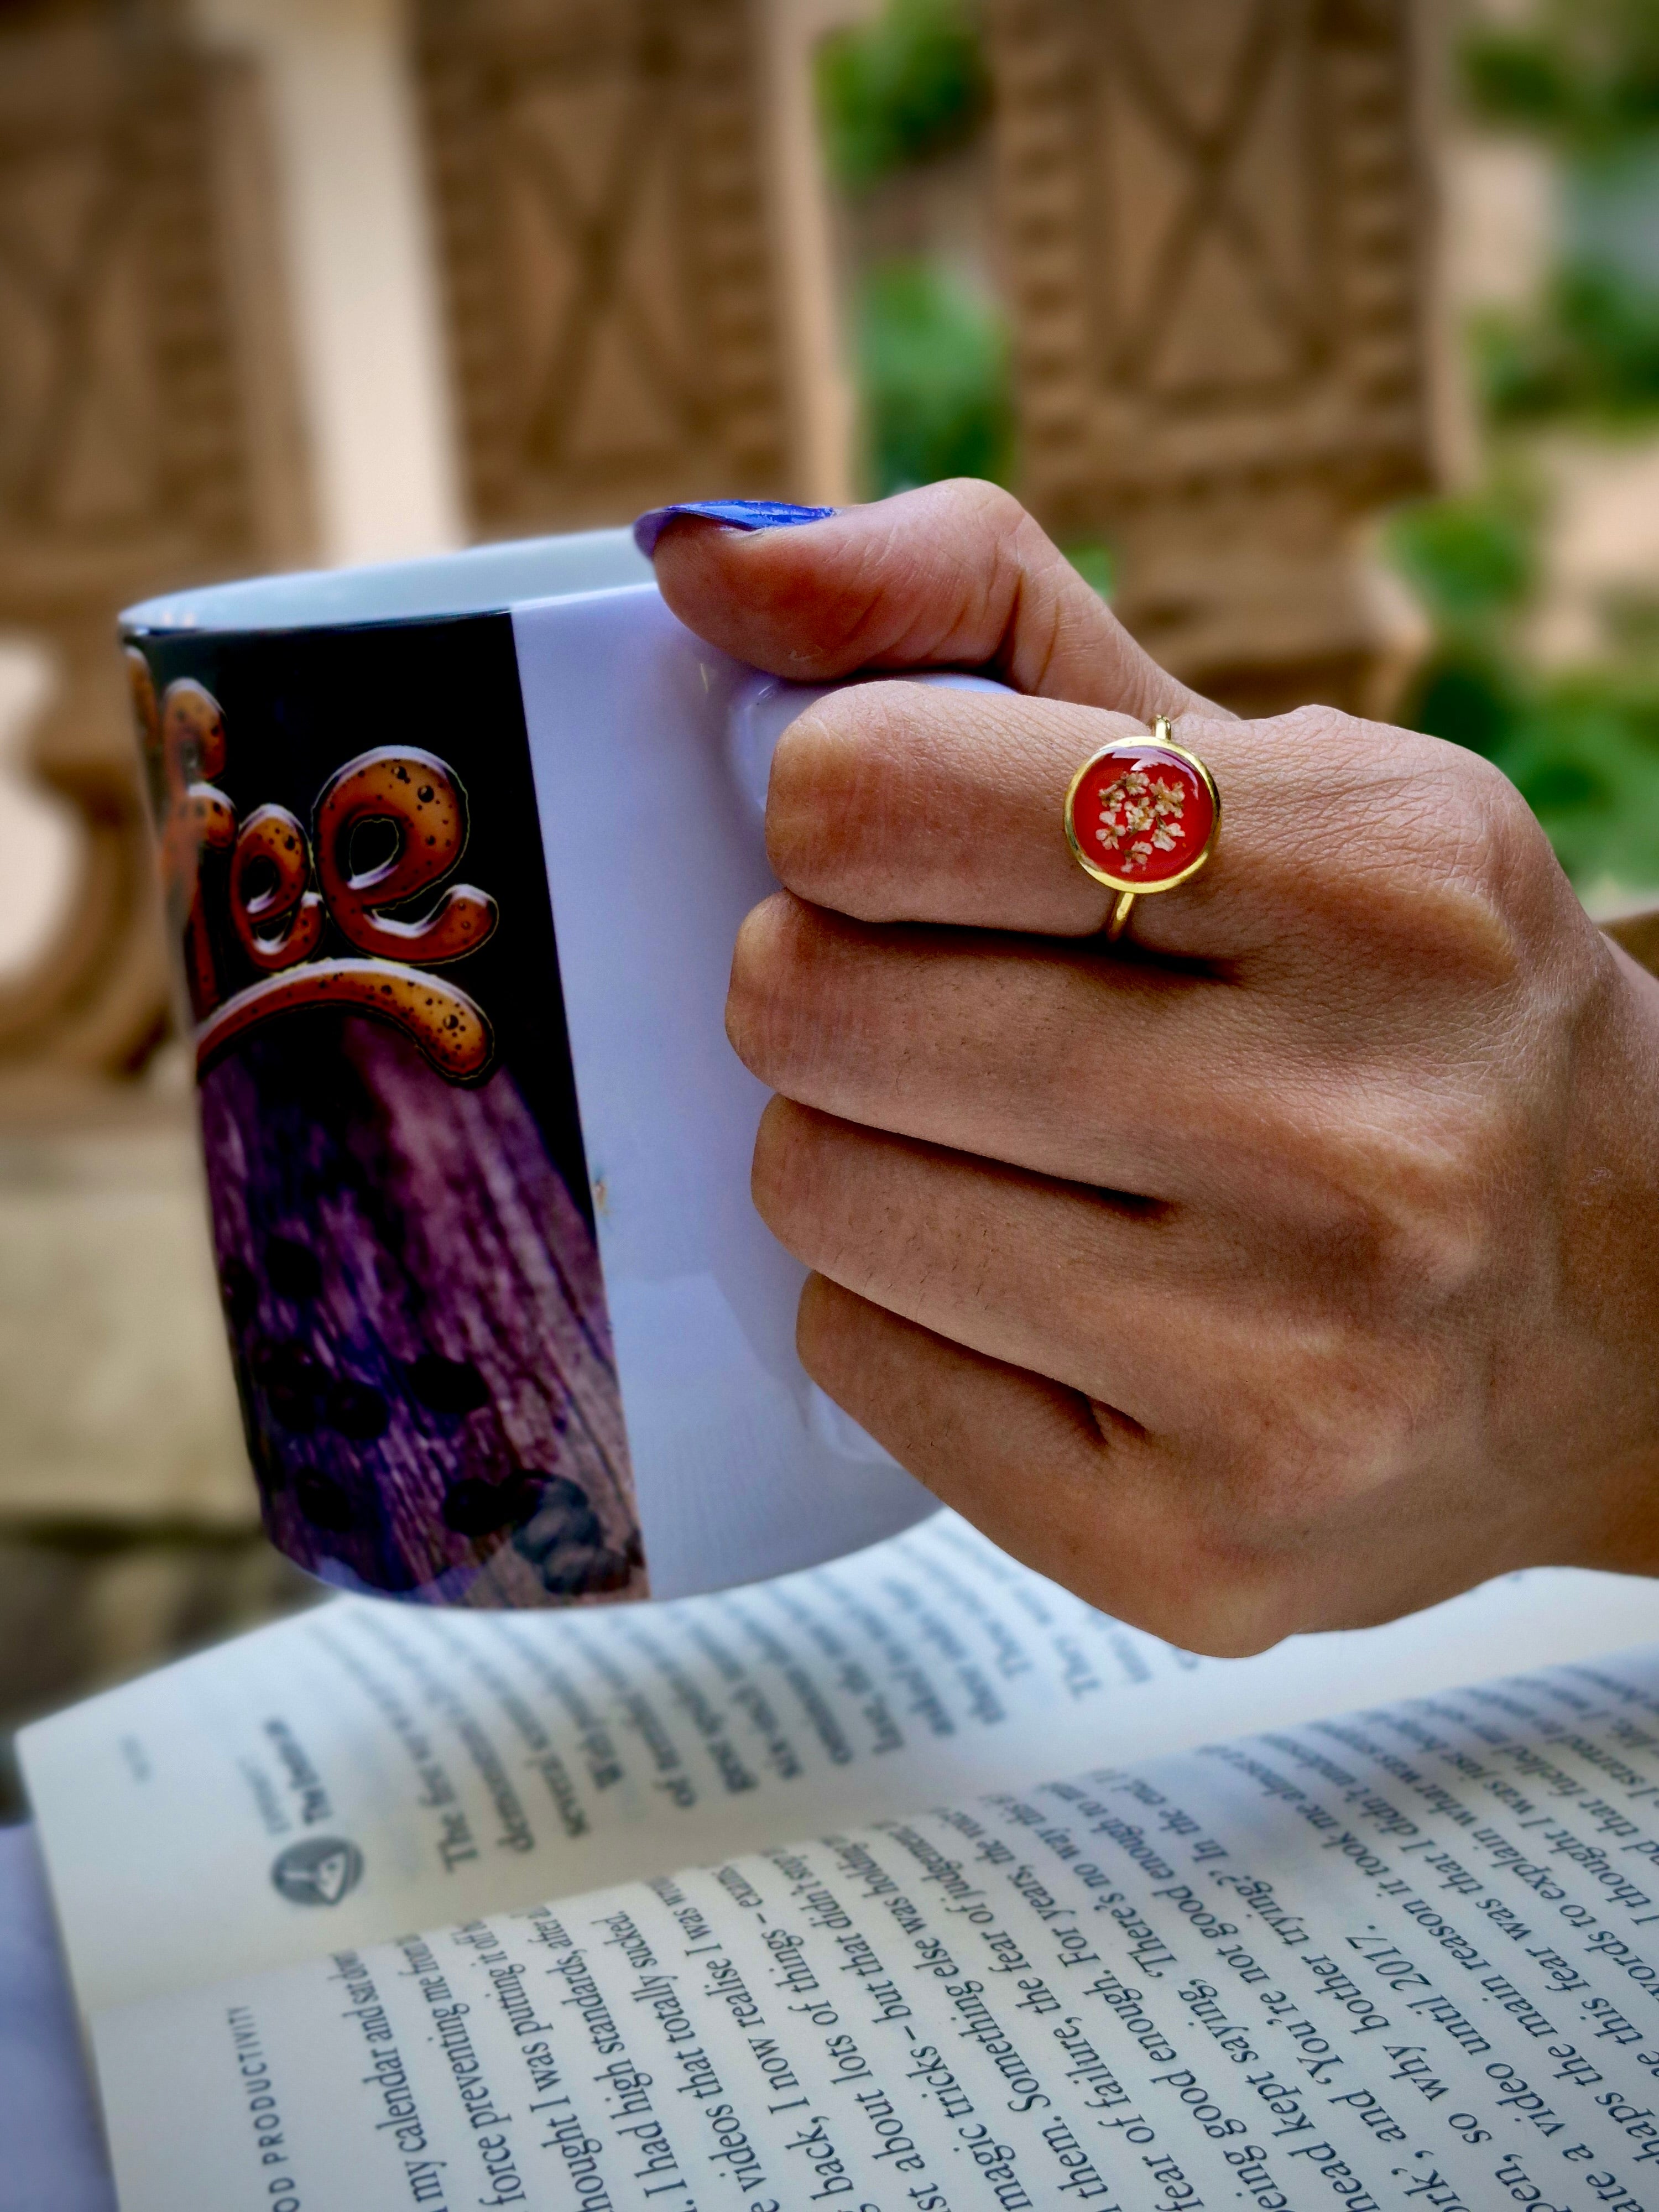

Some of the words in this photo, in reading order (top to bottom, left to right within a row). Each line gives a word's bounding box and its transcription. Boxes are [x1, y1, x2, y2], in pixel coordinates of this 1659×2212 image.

[1381, 1755, 1422, 1785] was
[1490, 1745, 1589, 1797] fuelled
[1546, 1735, 1646, 1786] started
[1077, 1801, 1109, 1818] to
[1159, 1809, 1201, 1836] the
[1296, 1804, 1339, 1830] me
[1344, 1787, 1420, 1836] didn’t
[1414, 1784, 1478, 1828] what
[1484, 1781, 1535, 1815] was
[1519, 1817, 1556, 1829] I
[1578, 1799, 1640, 1838] that
[974, 1839, 1016, 1865] the
[1039, 1828, 1081, 1861] way
[1089, 1818, 1176, 1881] enough
[1191, 1839, 1230, 1864] In
[1322, 1831, 1390, 1877] took
[1399, 1839, 1436, 1853] I
[1472, 1828, 1566, 1901] explain
[1545, 1830, 1652, 1908] thought
[1007, 1865, 1076, 1922] years,
[1073, 1864, 1112, 1889] no
[1376, 1879, 1412, 1897] it
[1424, 1853, 1484, 1895] that
[673, 1907, 712, 1941] was
[790, 1880, 853, 1929] didn’t
[884, 1897, 927, 1936] was
[945, 1902, 994, 1924] of
[1151, 1885, 1239, 1938] good
[1475, 1898, 1532, 1942] was
[1559, 1905, 1597, 1928] to
[471, 1950, 508, 1967] it
[527, 1919, 573, 1949] after
[591, 1911, 658, 1969] sucked.
[684, 1943, 723, 1957] I
[834, 1933, 884, 1977] that
[912, 1938, 959, 1978] else
[980, 1931, 1032, 1973] fear
[1051, 1927, 1101, 1968] For
[1093, 1892, 1178, 1978] ‘There’s
[1345, 1925, 1432, 1991] 2017.
[1402, 1899, 1491, 1971] reason
[761, 1929, 820, 1994] things
[1216, 1944, 1270, 1984] not
[1525, 1947, 1591, 1992] fear
[346, 1980, 379, 2005] sat
[419, 1975, 452, 2004] me
[485, 1964, 554, 2037] putting
[545, 1949, 625, 2054] standards,
[630, 1975, 696, 2044] totally
[704, 1958, 765, 2028] realise
[787, 2000, 839, 2026] of
[865, 1980, 912, 2024] but
[1015, 1978, 1061, 2015] the
[1301, 1954, 1391, 2035] bother
[1480, 1974, 1558, 2038] main
[341, 2005, 393, 2043] and
[1082, 1969, 1177, 2062] enough.
[1177, 1979, 1259, 2063] saying,
[1259, 1990, 1344, 2085] ‘You’re
[1406, 1995, 1491, 2056] until
[1579, 1997, 1644, 2045] this
[427, 2003, 513, 2130] preventing
[521, 2042, 561, 2093] was
[747, 2038, 800, 2091] now
[825, 2034, 873, 2085] lots
[945, 1980, 1051, 2112] Something
[1053, 2016, 1131, 2108] failure,
[1547, 2043, 1603, 2086] the
[228, 2008, 288, 2166] PRODUCTIVITY
[593, 2058, 653, 2120] high
[674, 2047, 724, 2099] that
[906, 2046, 975, 2119] tricks
[1383, 2045, 1449, 2102] why
[362, 2048, 427, 2153] calendar
[529, 2095, 571, 2113] I
[768, 2096, 810, 2115] I
[1149, 2069, 1247, 2138] good
[1245, 2071, 1316, 2137] kept
[1327, 2088, 1407, 2142] and
[1485, 2063, 1566, 2137] video
[615, 2120, 679, 2178] had
[705, 2104, 766, 2193] videos
[854, 2089, 925, 2172] about
[1097, 2114, 1155, 2144] of
[1448, 2112, 1493, 2144] so
[1562, 2143, 1594, 2162] a
[405, 2161, 447, 2203] my
[478, 2134, 526, 2206] force
[540, 2114, 613, 2210] hought
[785, 2116, 854, 2201] back,
[953, 2124, 1033, 2211] magic
[1042, 2116, 1109, 2199] them.
[1141, 2153, 1204, 2211] fear
[1223, 2145, 1287, 2209] eing
[1287, 2141, 1380, 2211] head
[268, 2177, 300, 2211] OD
[643, 2178, 687, 2198] I
[907, 2183, 947, 2210] st
